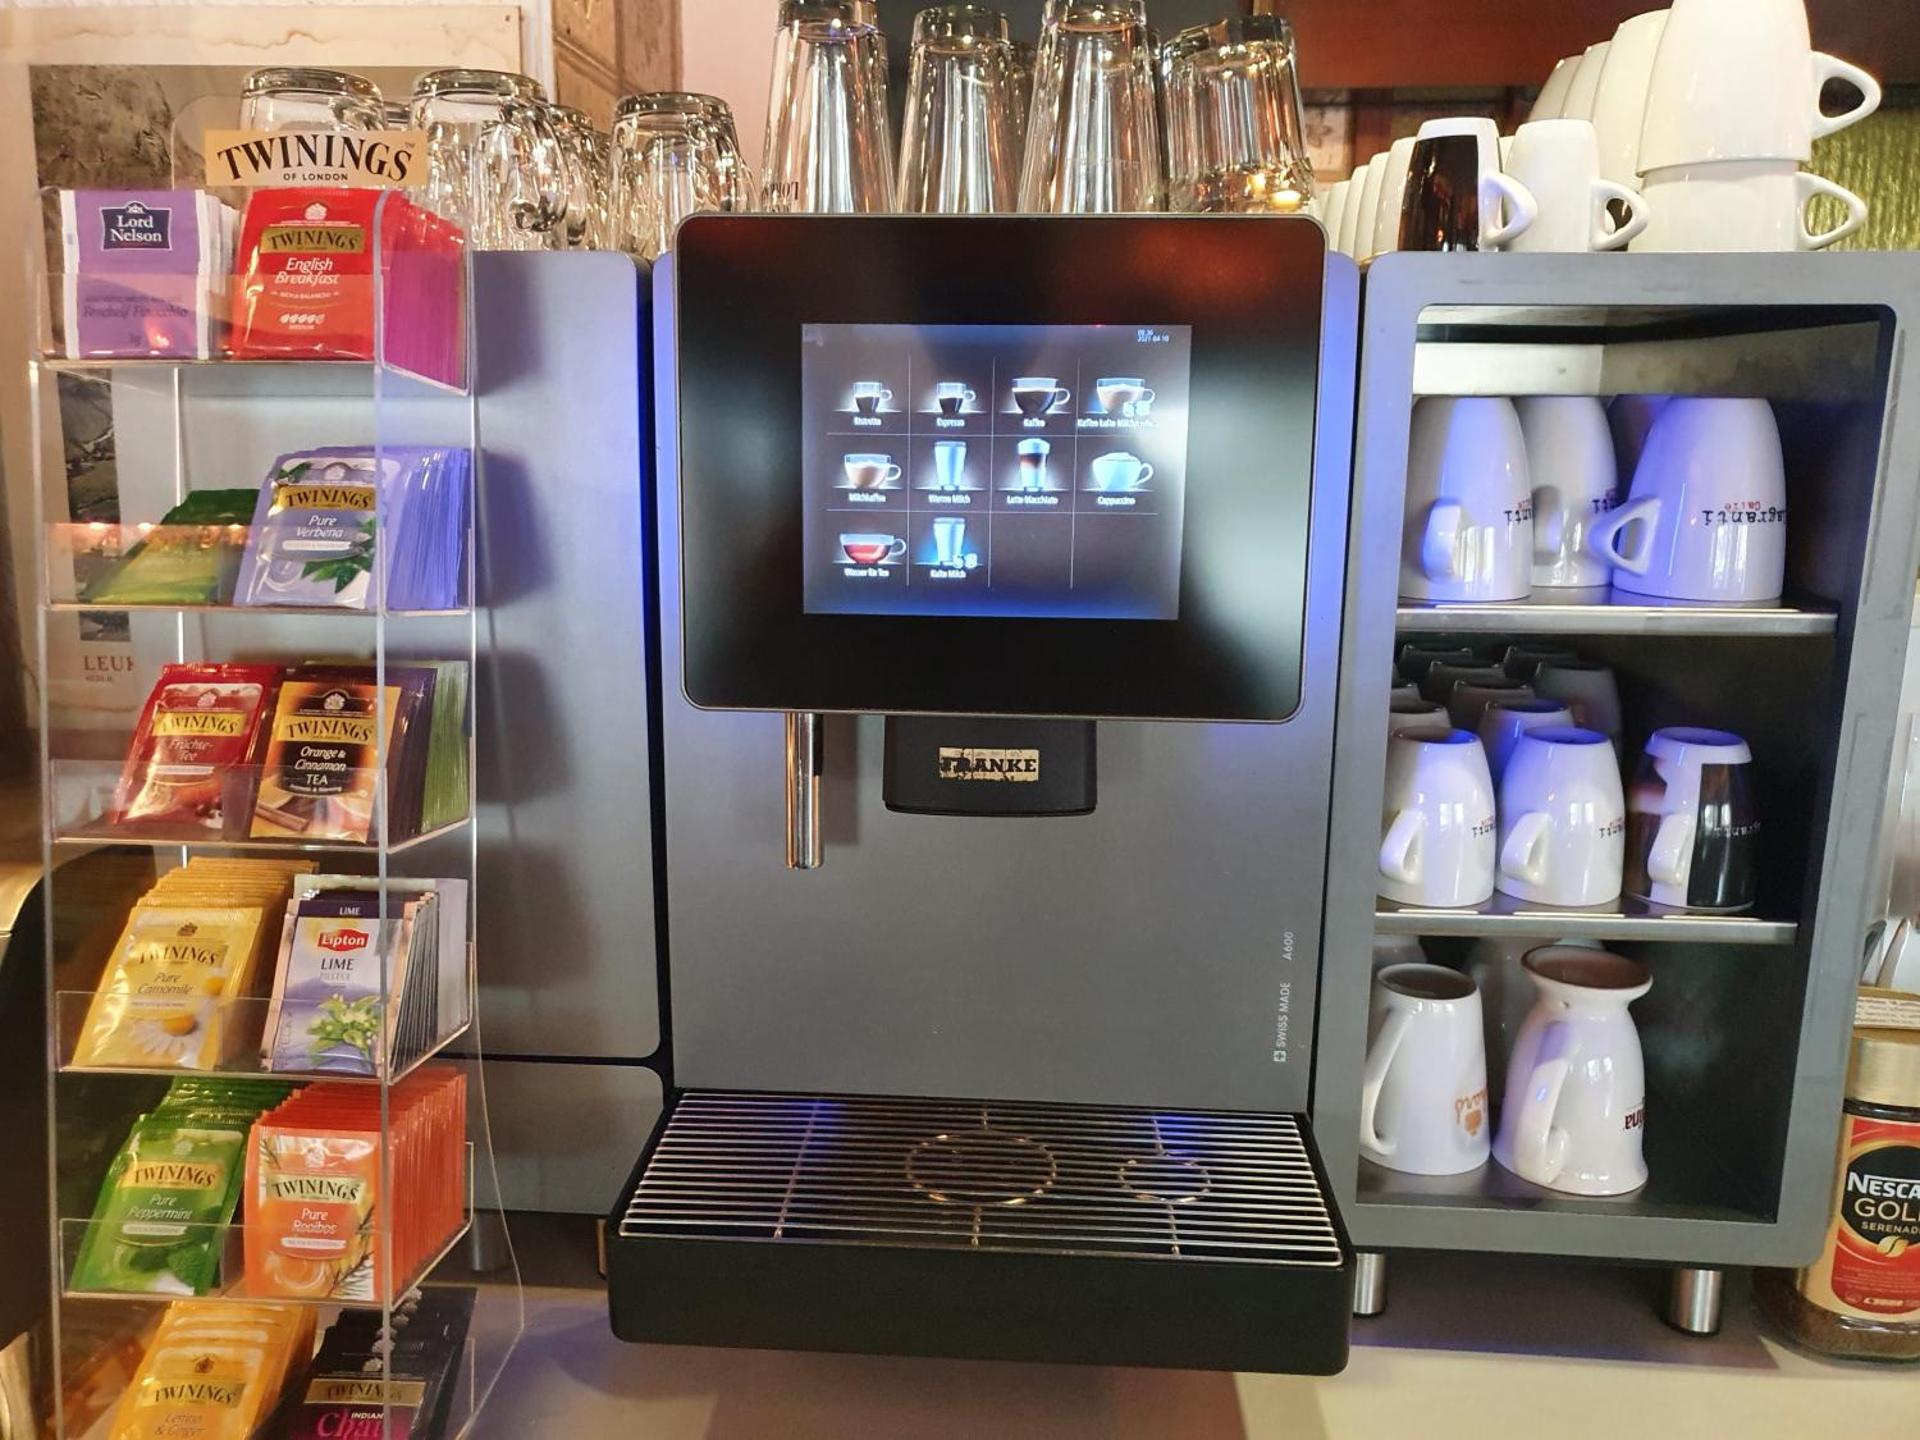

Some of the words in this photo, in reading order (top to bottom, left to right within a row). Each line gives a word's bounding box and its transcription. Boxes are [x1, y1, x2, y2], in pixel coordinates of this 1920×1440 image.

[217, 134, 412, 182] TWININGS
[283, 173, 297, 181] OF
[303, 173, 348, 181] LONDON
[116, 214, 154, 228] Lord
[110, 228, 162, 242] Nelson
[267, 229, 360, 250] TWININGS
[285, 257, 333, 274] English
[275, 271, 340, 287] Breakfast
[285, 488, 372, 508] TWININGS
[308, 515, 337, 526] Pure
[296, 527, 344, 538] Verbena
[287, 719, 374, 742] TWININGS
[300, 745, 339, 760] Orange
[337, 749, 347, 758] &
[294, 758, 347, 771] Cinnamon
[305, 773, 329, 785] TEA
[339, 906, 361, 915] LIME
[321, 932, 366, 949] Lipton
[1282, 931, 1294, 961] A600
[321, 958, 355, 971] LIME
[154, 972, 182, 983] Pure
[137, 983, 195, 996] Camomile
[1278, 982, 1291, 1013] MADE
[1275, 1015, 1289, 1048] SWISS
[134, 1165, 216, 1187] TWININGS
[273, 1178, 360, 1201] TWININGS
[150, 1193, 177, 1206] Pure
[128, 1206, 193, 1220] Peppermint
[301, 1208, 329, 1221] Pure
[292, 1221, 338, 1235] Rooibos
[155, 1383, 236, 1404] TWININGS
